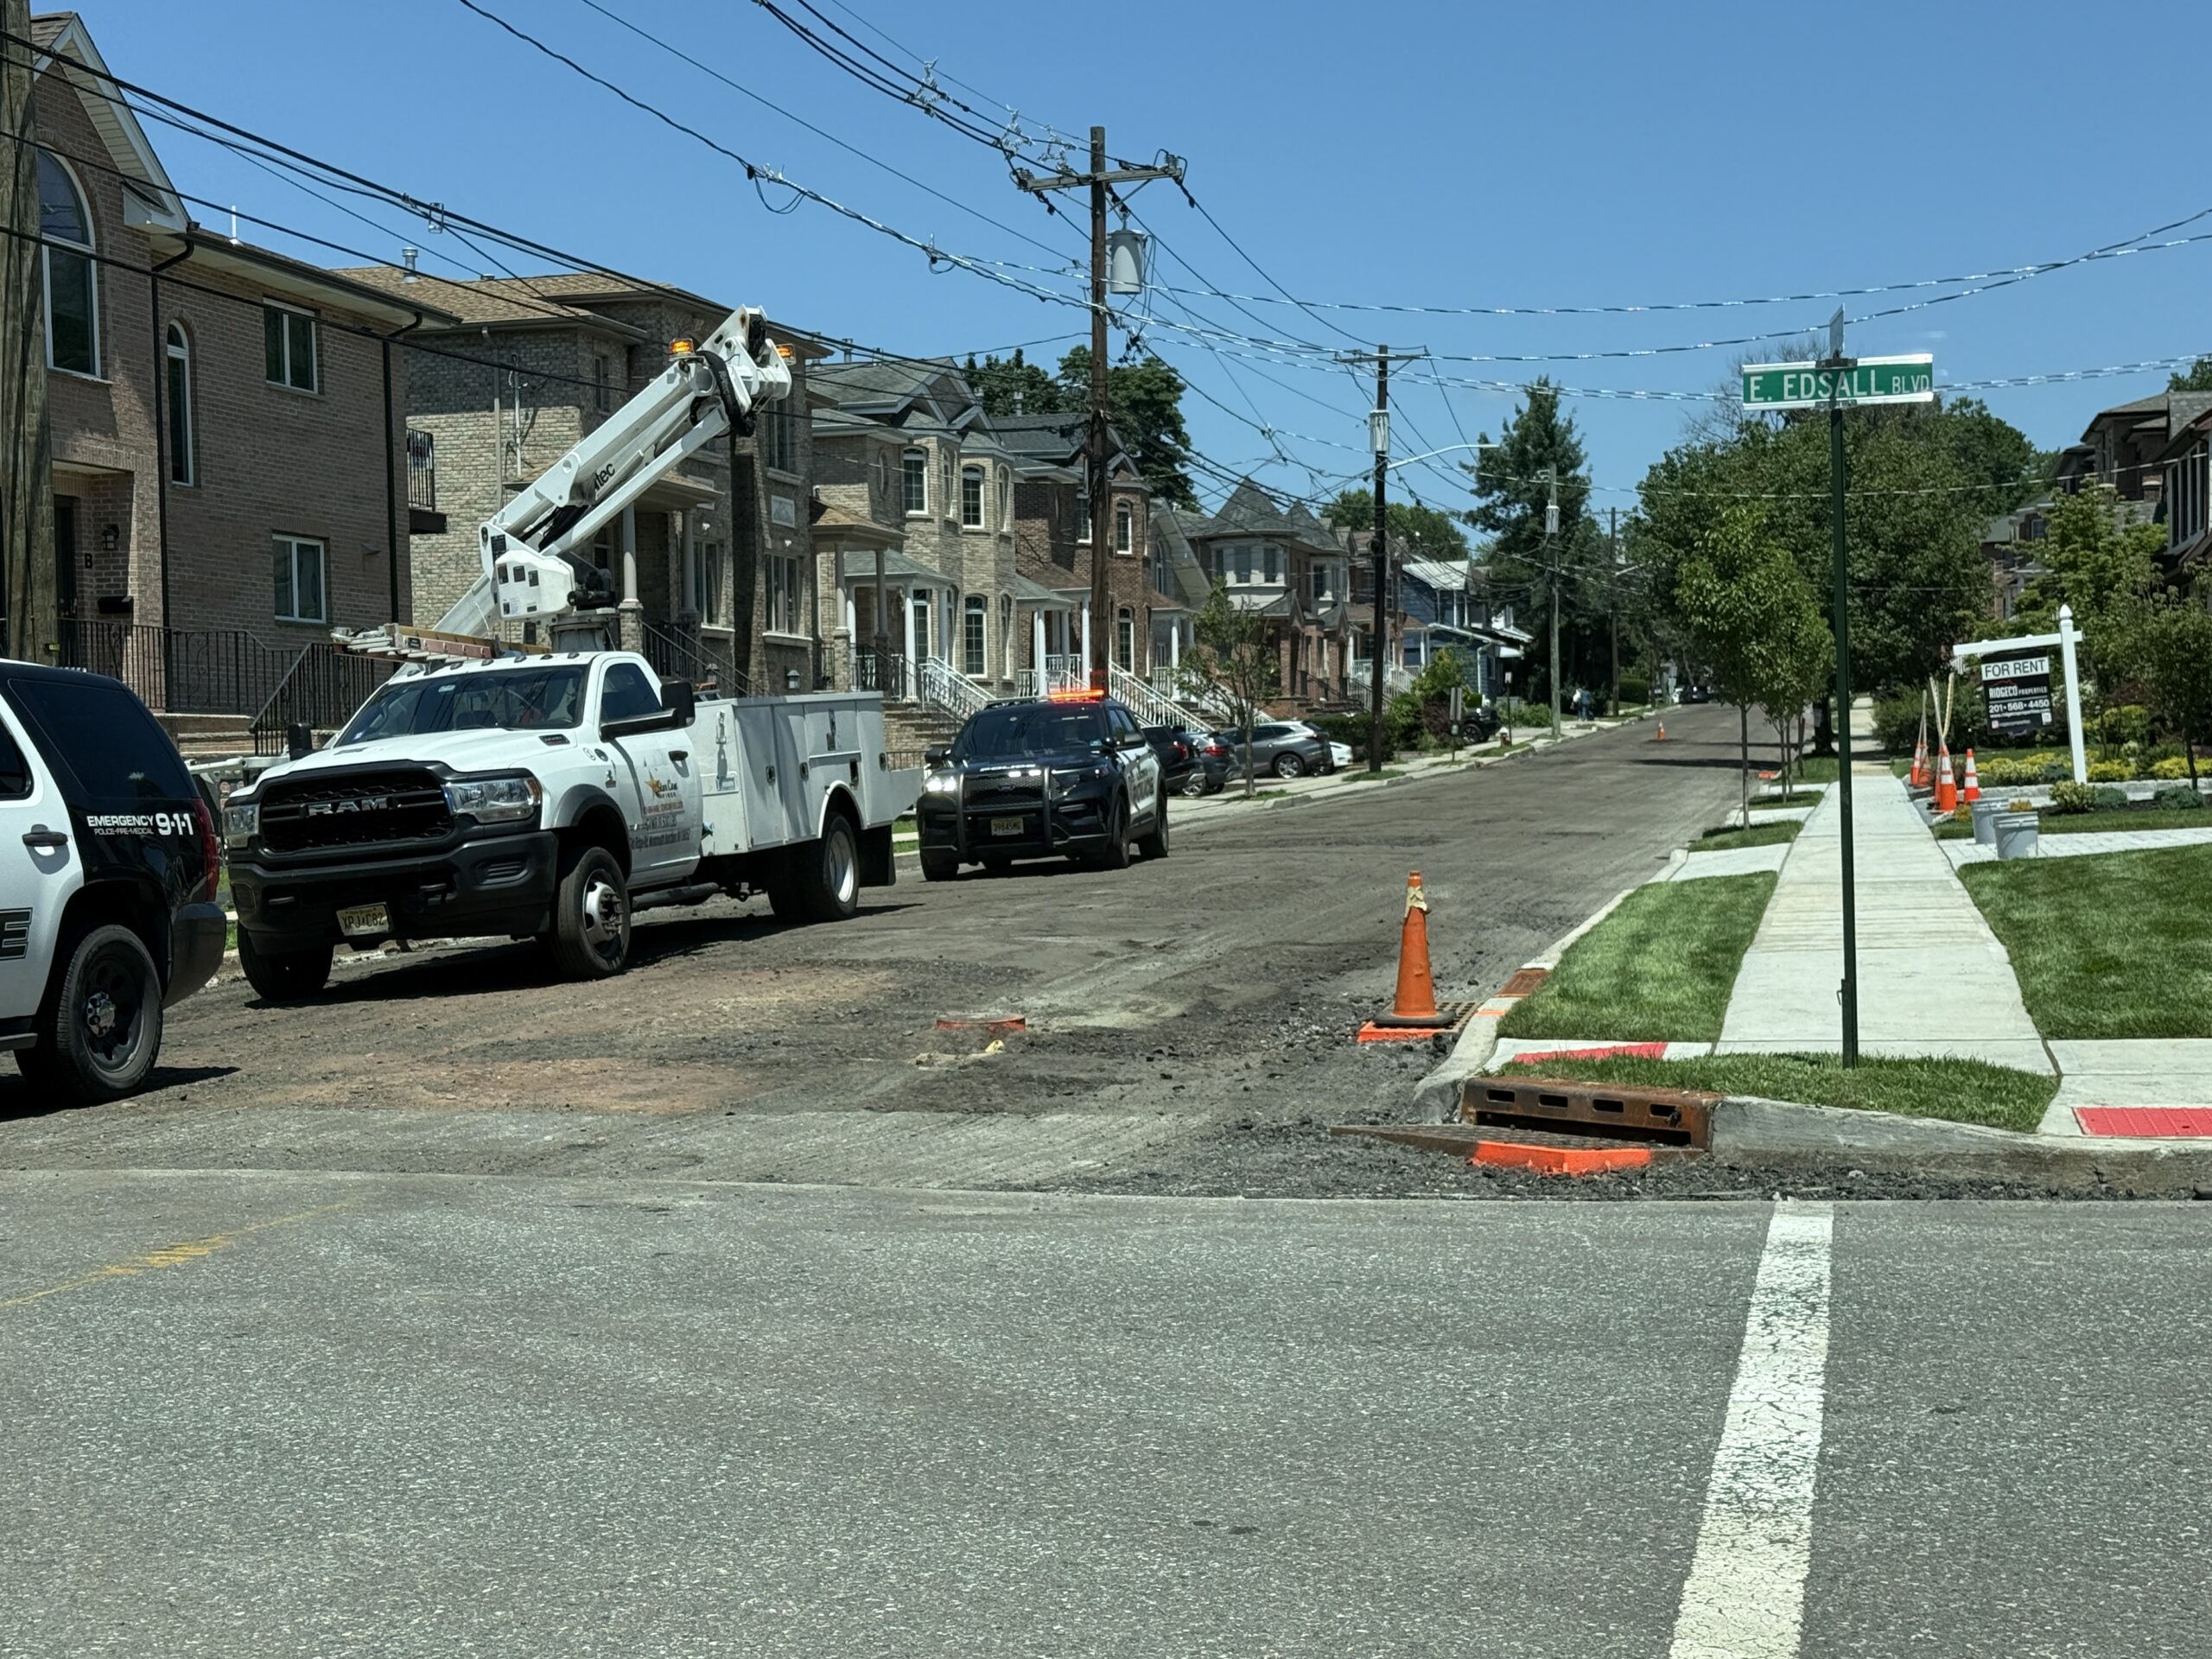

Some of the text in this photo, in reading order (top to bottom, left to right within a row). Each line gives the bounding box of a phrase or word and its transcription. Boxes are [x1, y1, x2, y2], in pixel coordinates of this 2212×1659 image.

[1749, 369, 1930, 402] E. EDSALL BLVD
[1984, 658, 2045, 678] FOR RENT
[1988, 685, 2048, 699] RIDGECO PROPERTIES
[308, 797, 388, 817] RAM
[86, 815, 155, 828] EMERGENCY
